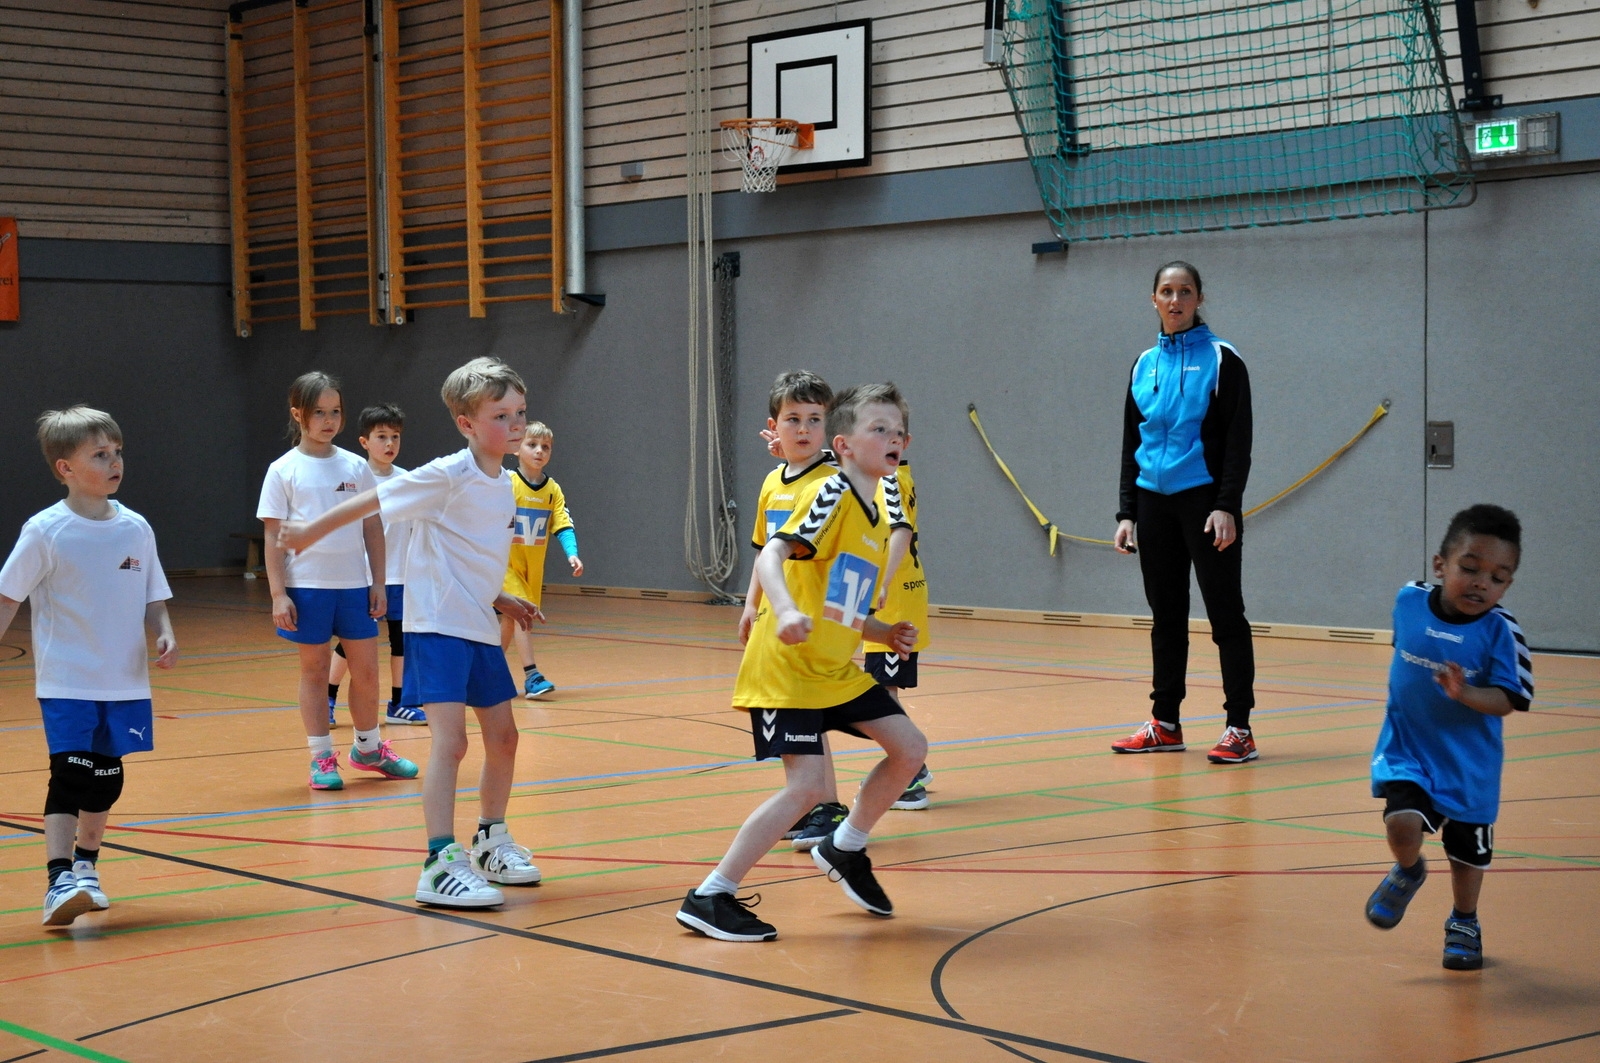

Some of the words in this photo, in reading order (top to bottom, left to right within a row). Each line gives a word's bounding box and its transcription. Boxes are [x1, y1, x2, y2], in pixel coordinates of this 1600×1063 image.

[1425, 626, 1464, 644] hummel
[784, 731, 818, 743] hummel
[67, 756, 94, 769] SELECT
[94, 766, 121, 777] SELECT
